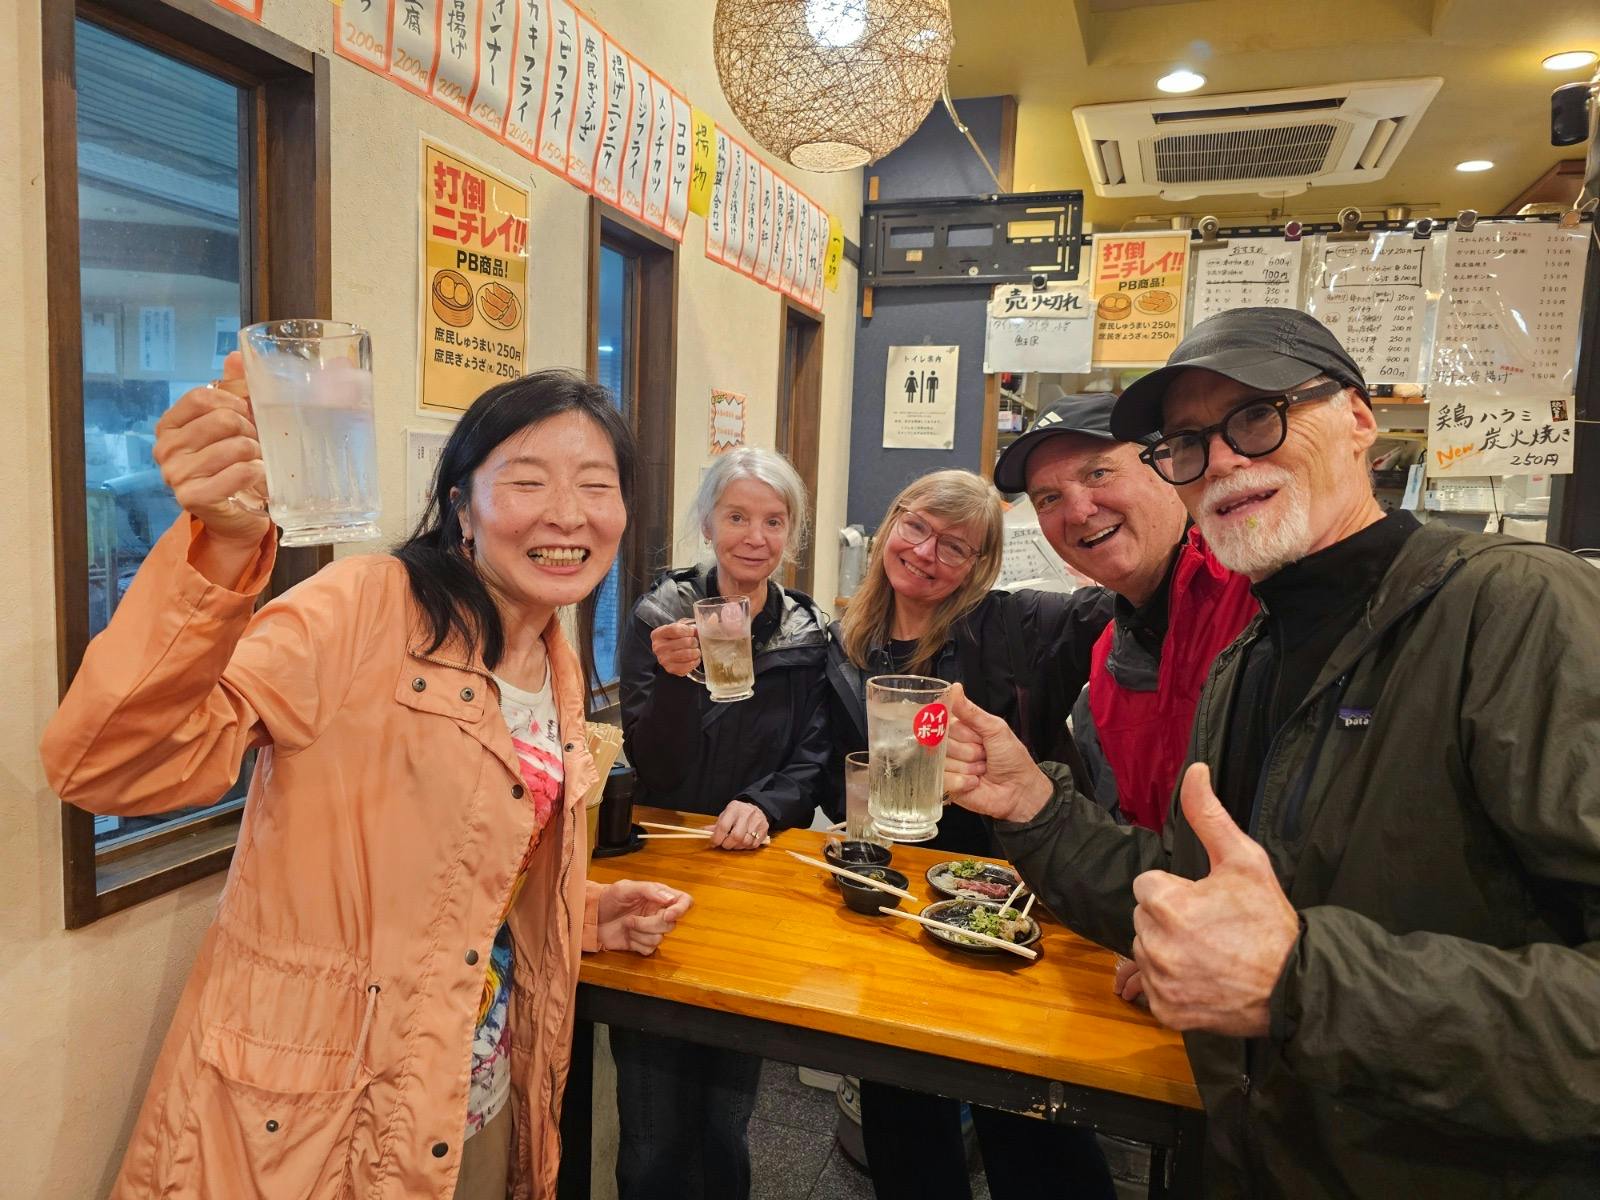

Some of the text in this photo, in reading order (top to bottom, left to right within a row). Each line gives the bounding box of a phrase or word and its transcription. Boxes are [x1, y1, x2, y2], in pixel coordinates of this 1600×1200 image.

[401, 0, 425, 36] 腐
[346, 21, 385, 60] 200円
[393, 47, 429, 82] 200円
[517, 0, 541, 123] カキフライ
[550, 18, 572, 130] エビフライ
[578, 34, 600, 142] 庶民ぎょうざ
[602, 54, 626, 169] 揚げニンニク
[630, 82, 648, 179] アジフライ
[652, 95, 668, 194] メンチカツ
[672, 121, 688, 195] コロッケ
[693, 124, 710, 192] 揚物
[433, 160, 487, 215] 打倒
[456, 249, 509, 279] PB商品!
[1103, 240, 1146, 262] 打倒
[1232, 246, 1265, 256] おすすめ
[1118, 277, 1165, 291] PB商品!
[1262, 268, 1288, 280] 700円
[1004, 288, 1083, 313] 売り切れ
[1098, 320, 1176, 330] 庶民しゅうまい 250円
[1151, 331, 1175, 340] 250円
[433, 326, 521, 362] 庶民しゅうまい 250円
[496, 361, 521, 381] 250円
[1379, 365, 1405, 377] 600円
[1436, 402, 1533, 432] 鶏ハラミ
[1478, 424, 1571, 451] 炭火焼き
[1435, 443, 1475, 465] New
[1510, 453, 1559, 467] 250円
[917, 724, 946, 739] ボール
[920, 710, 946, 724] ハイ
